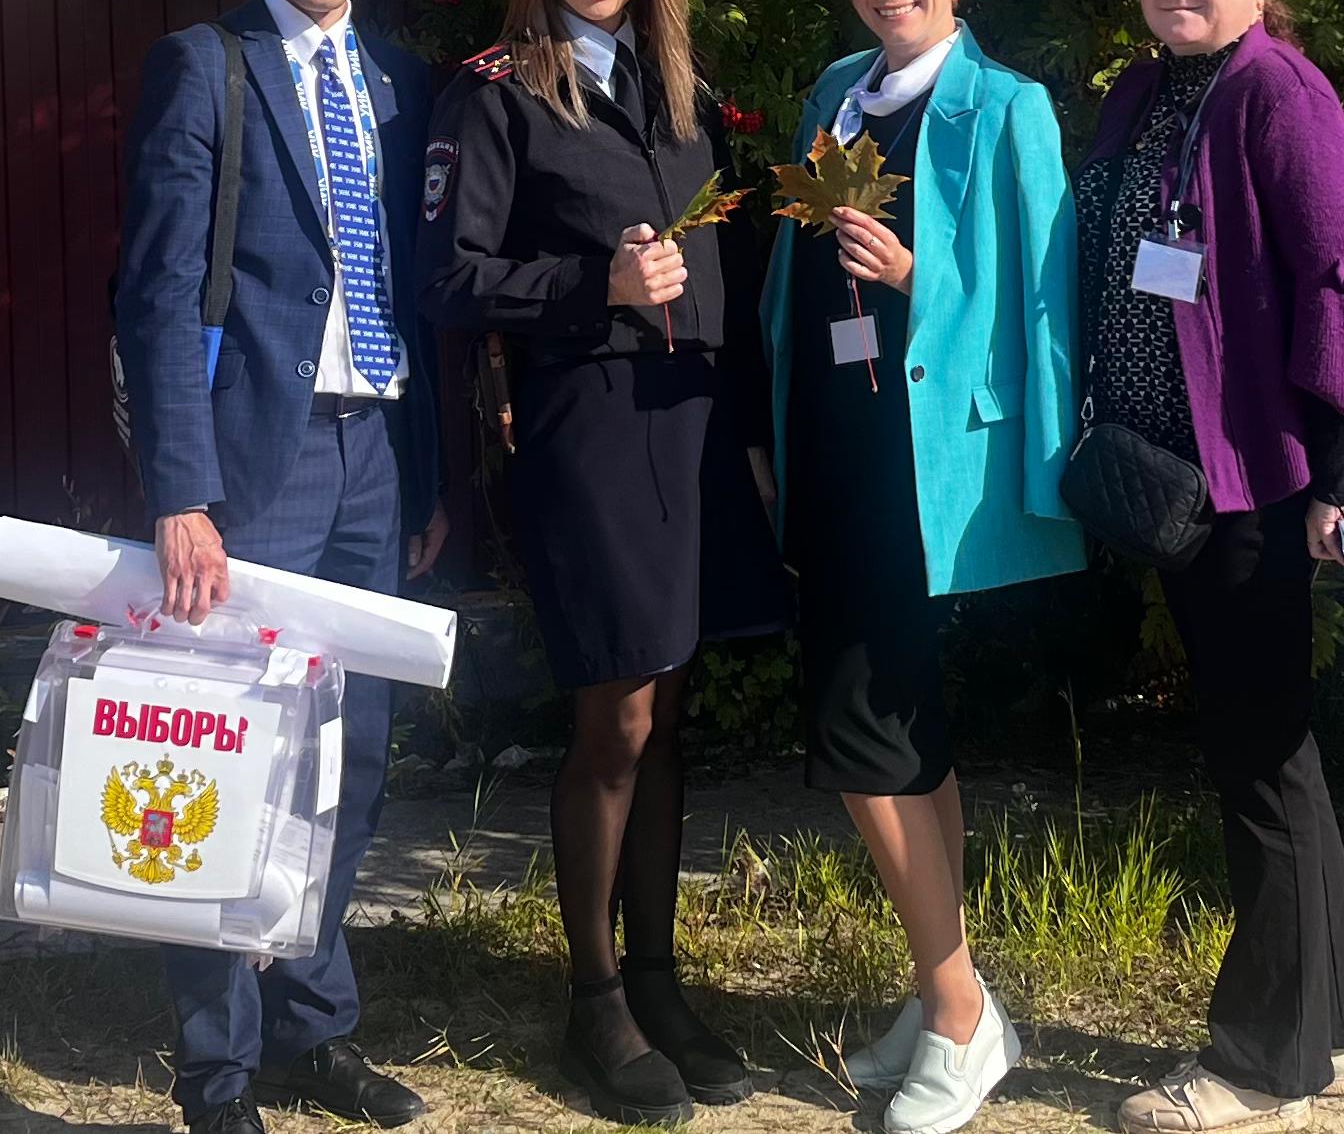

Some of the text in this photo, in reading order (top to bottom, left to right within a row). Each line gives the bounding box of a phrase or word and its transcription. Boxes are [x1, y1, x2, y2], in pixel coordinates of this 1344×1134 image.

[346, 49, 362, 77] УИК
[355, 88, 372, 117] УИК
[92, 697, 249, 754] ВЫБОРЫ
